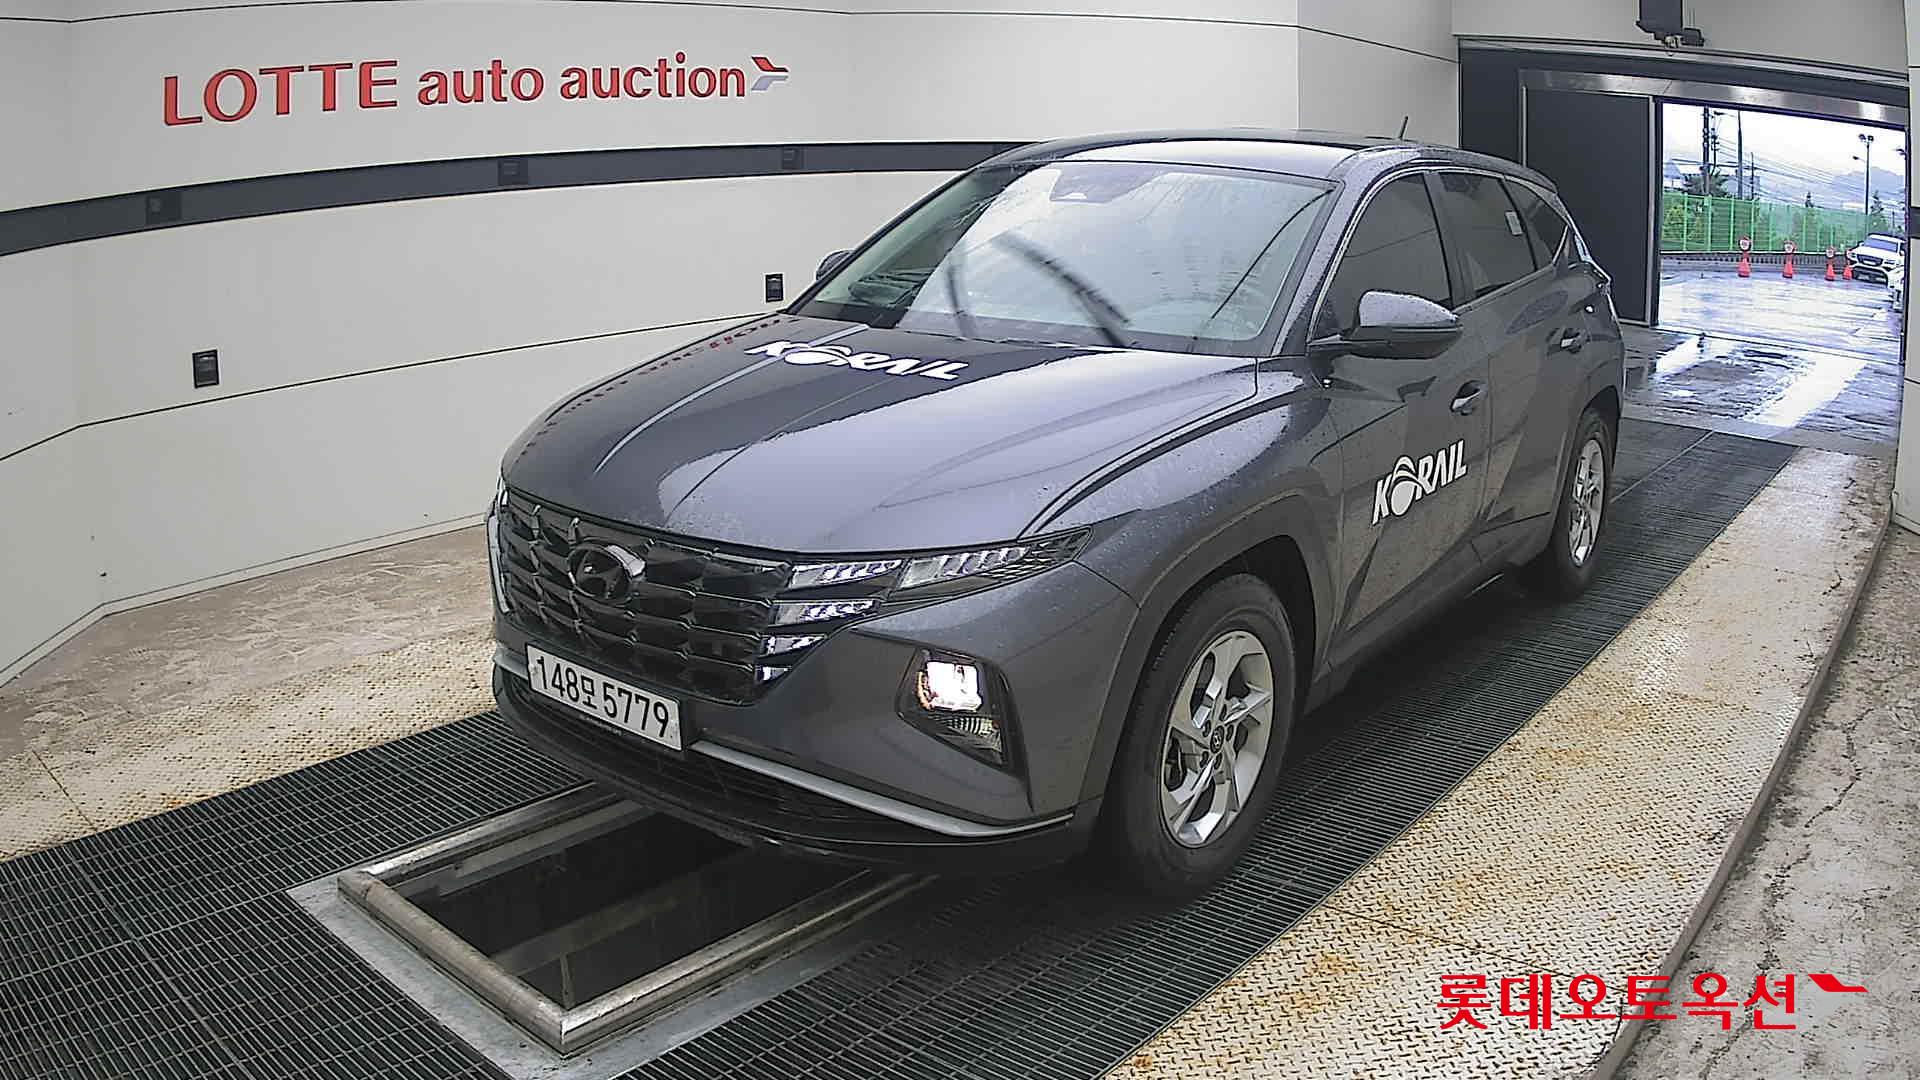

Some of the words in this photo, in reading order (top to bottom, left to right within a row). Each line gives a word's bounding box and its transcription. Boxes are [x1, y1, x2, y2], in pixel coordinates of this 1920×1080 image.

[163, 60, 397, 126] LOTTE
[417, 59, 544, 105] auto
[560, 52, 746, 99] auction
[744, 340, 969, 380] KORAIL
[1372, 440, 1467, 525] KORAIL
